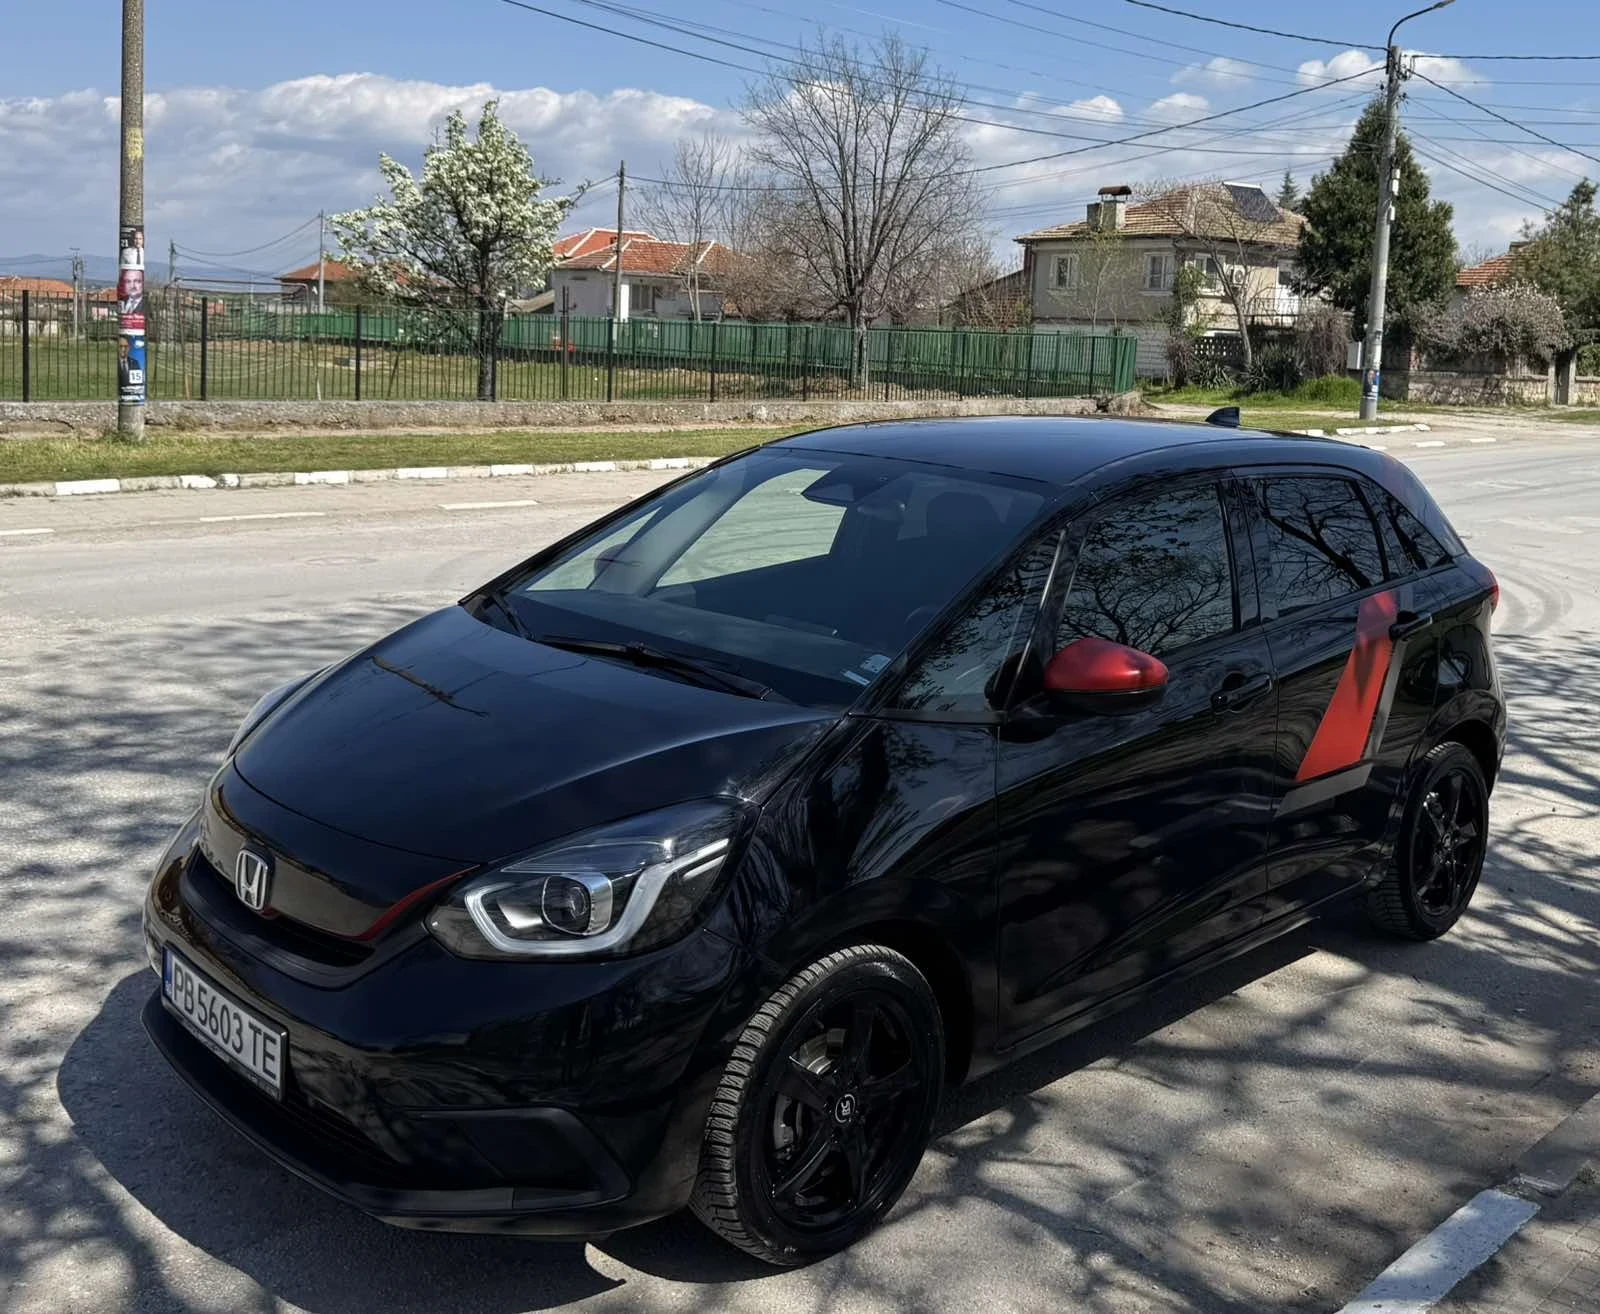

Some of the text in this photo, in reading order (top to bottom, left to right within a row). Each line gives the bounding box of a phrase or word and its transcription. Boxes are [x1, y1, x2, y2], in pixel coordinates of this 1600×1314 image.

[131, 371, 142, 381] 15
[174, 963, 194, 1016] PB
[197, 984, 244, 1054] 5603
[248, 1020, 277, 1081] TE
